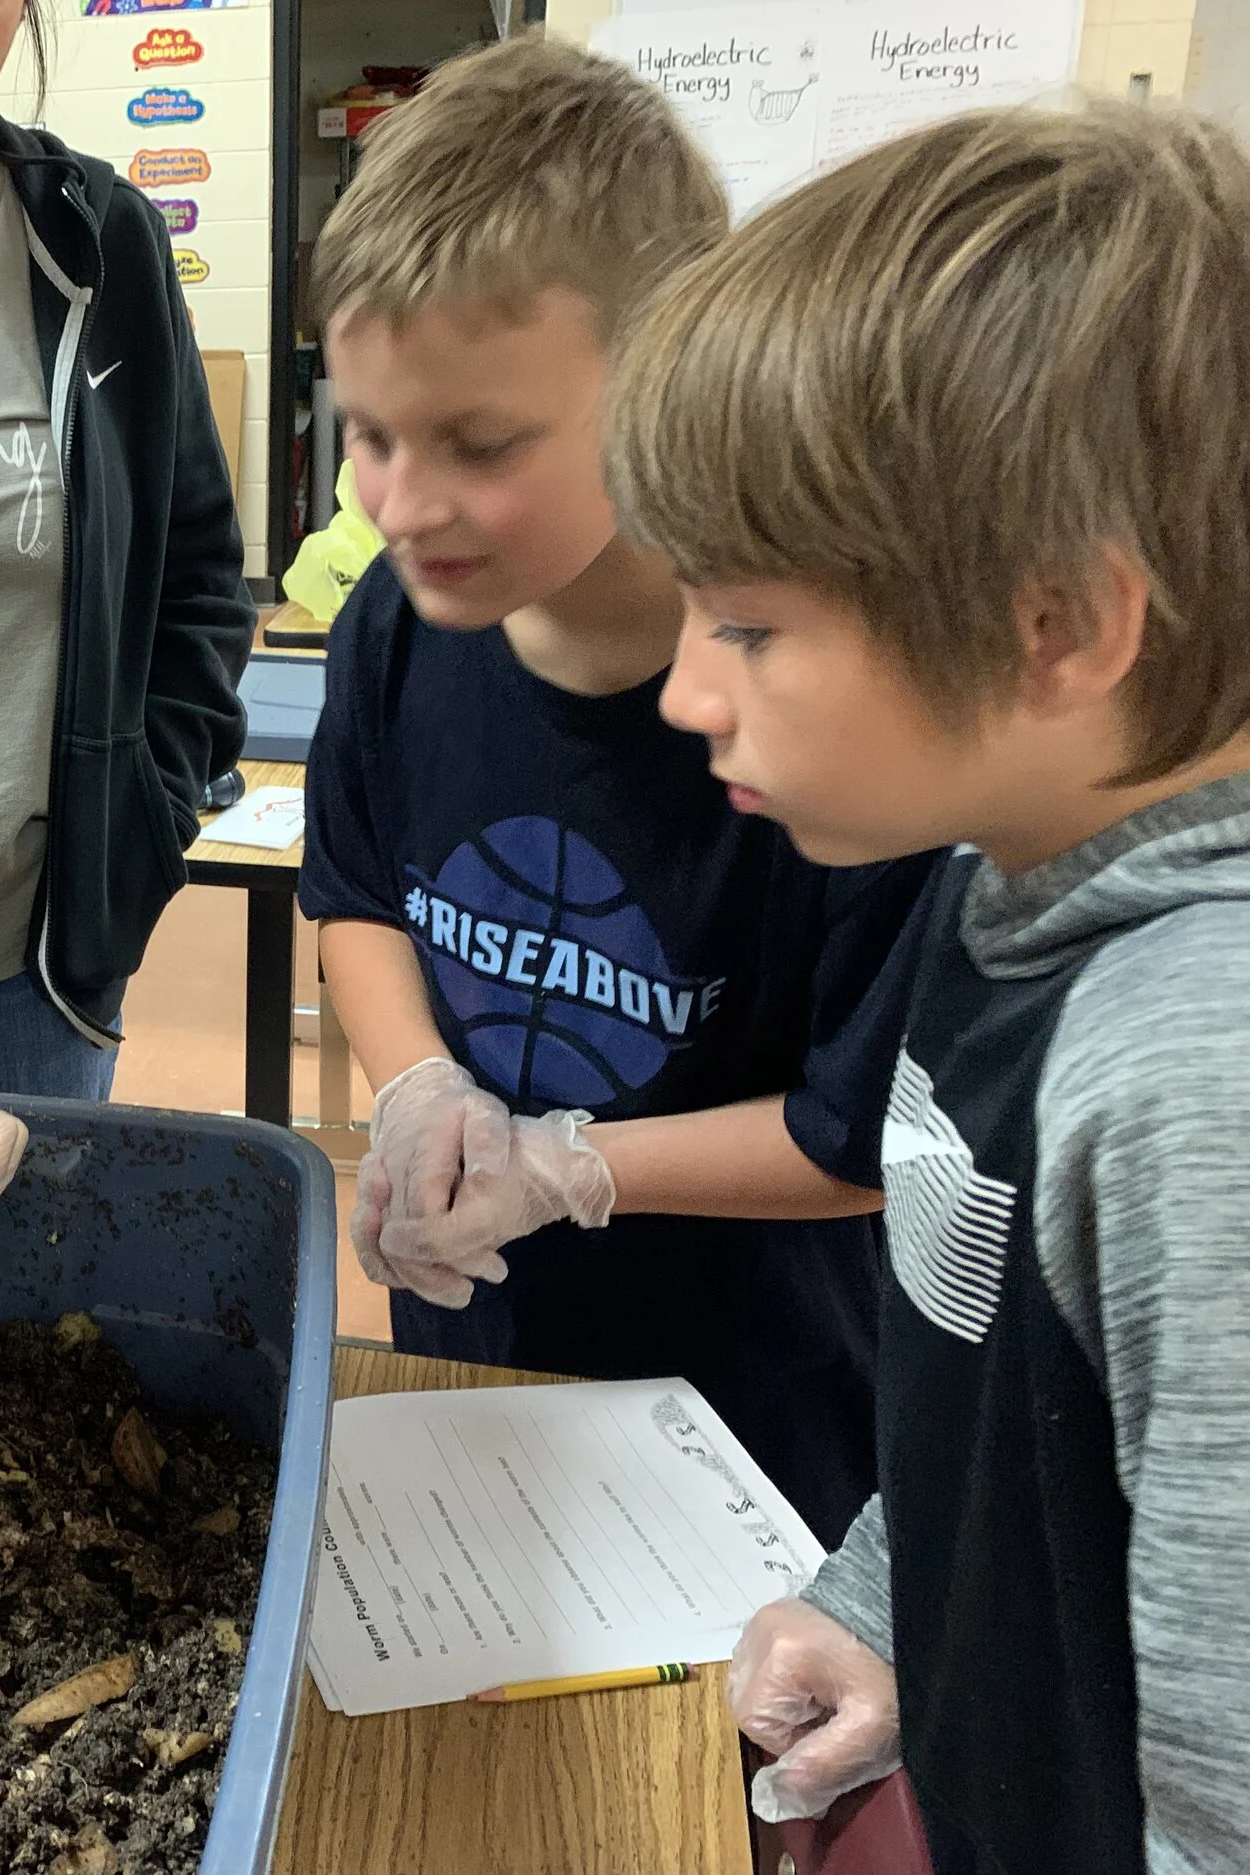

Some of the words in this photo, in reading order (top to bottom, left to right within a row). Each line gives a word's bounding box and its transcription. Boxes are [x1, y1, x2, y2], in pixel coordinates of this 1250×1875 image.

[139, 45, 195, 60] Question
[152, 33, 173, 46] Ask
[175, 34, 185, 44] a
[871, 24, 1019, 72] Hydroelectric
[637, 39, 772, 83] Hydroelectric
[900, 61, 980, 87] Energy
[663, 74, 731, 101] Energy
[138, 167, 203, 180] Experiment
[139, 155, 186, 166] Conduct
[188, 156, 202, 165] an
[405, 886, 726, 1034] #RISEABOVE
[334, 1556, 370, 1620] Population
[366, 1625, 390, 1661] Worm
